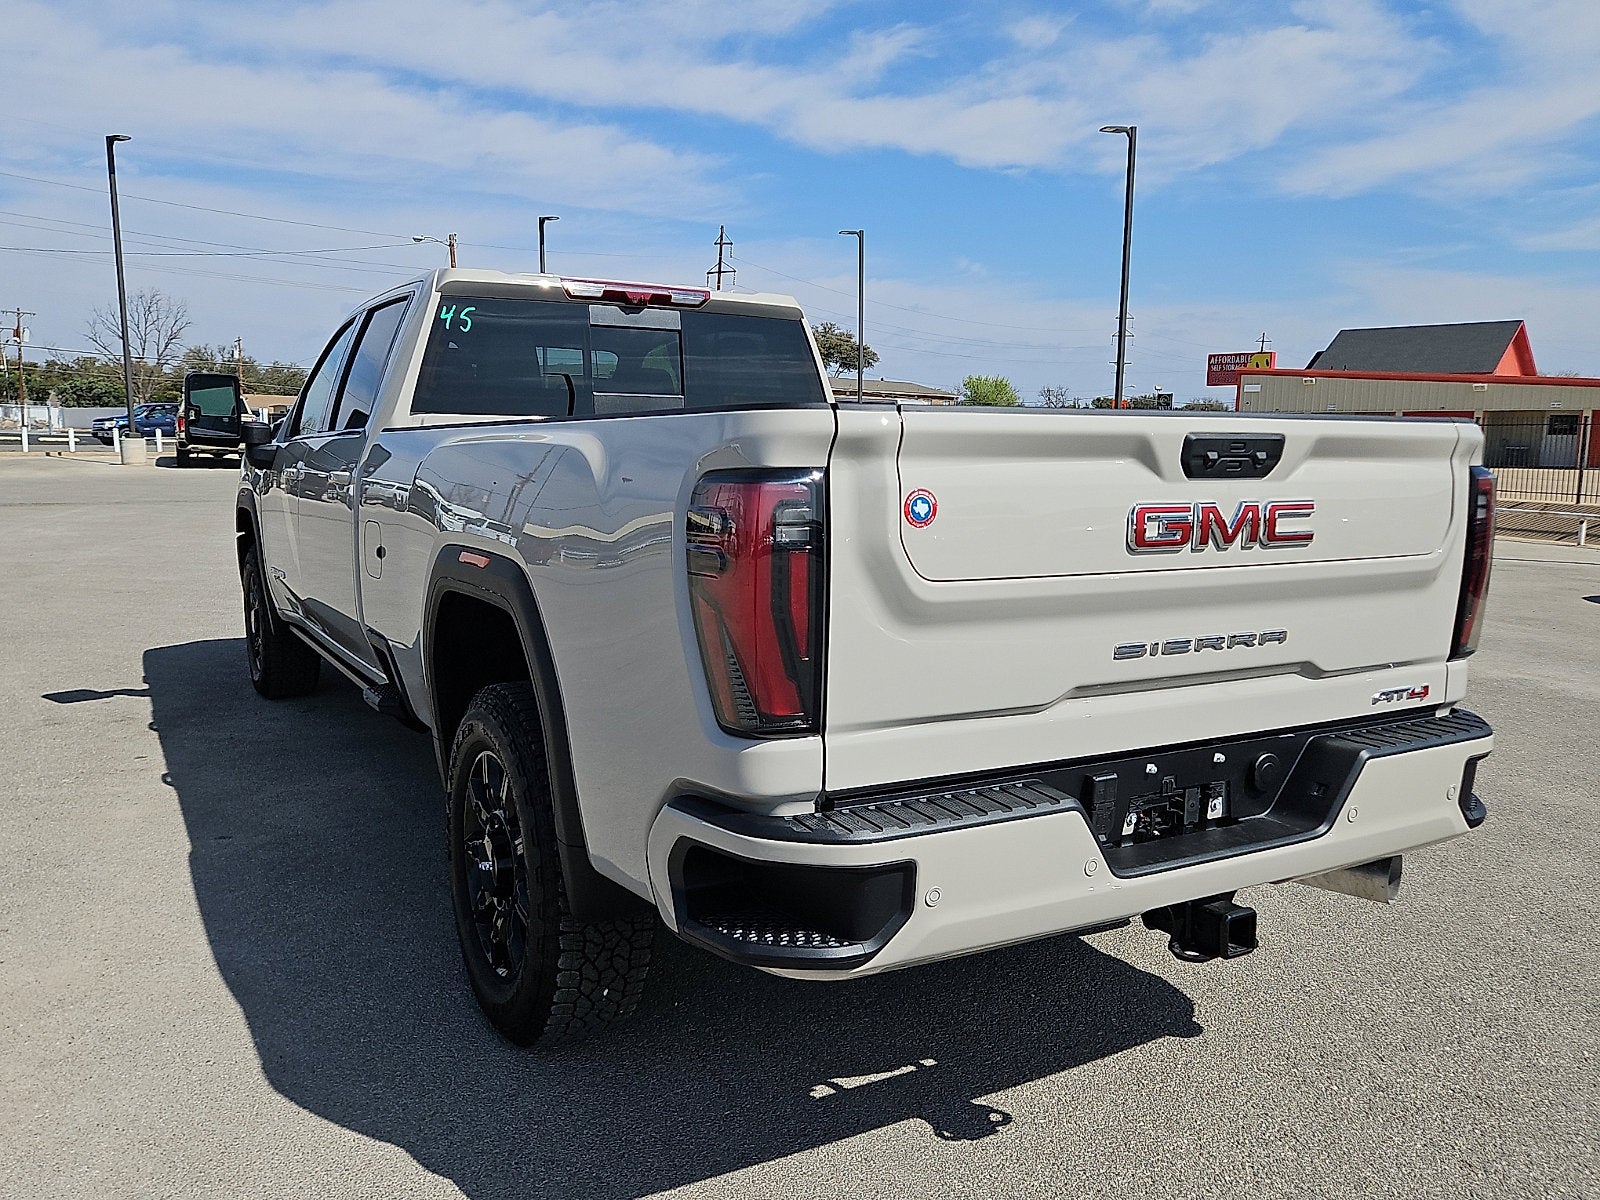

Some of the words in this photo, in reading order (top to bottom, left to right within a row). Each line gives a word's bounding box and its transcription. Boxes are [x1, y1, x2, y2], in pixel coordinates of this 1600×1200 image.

[440, 304, 476, 333] 45
[1210, 354, 1251, 364] AFFORDABLE
[1126, 499, 1316, 557] GMC
[1112, 628, 1289, 661] SIERRA
[1371, 684, 1430, 706] AT4
